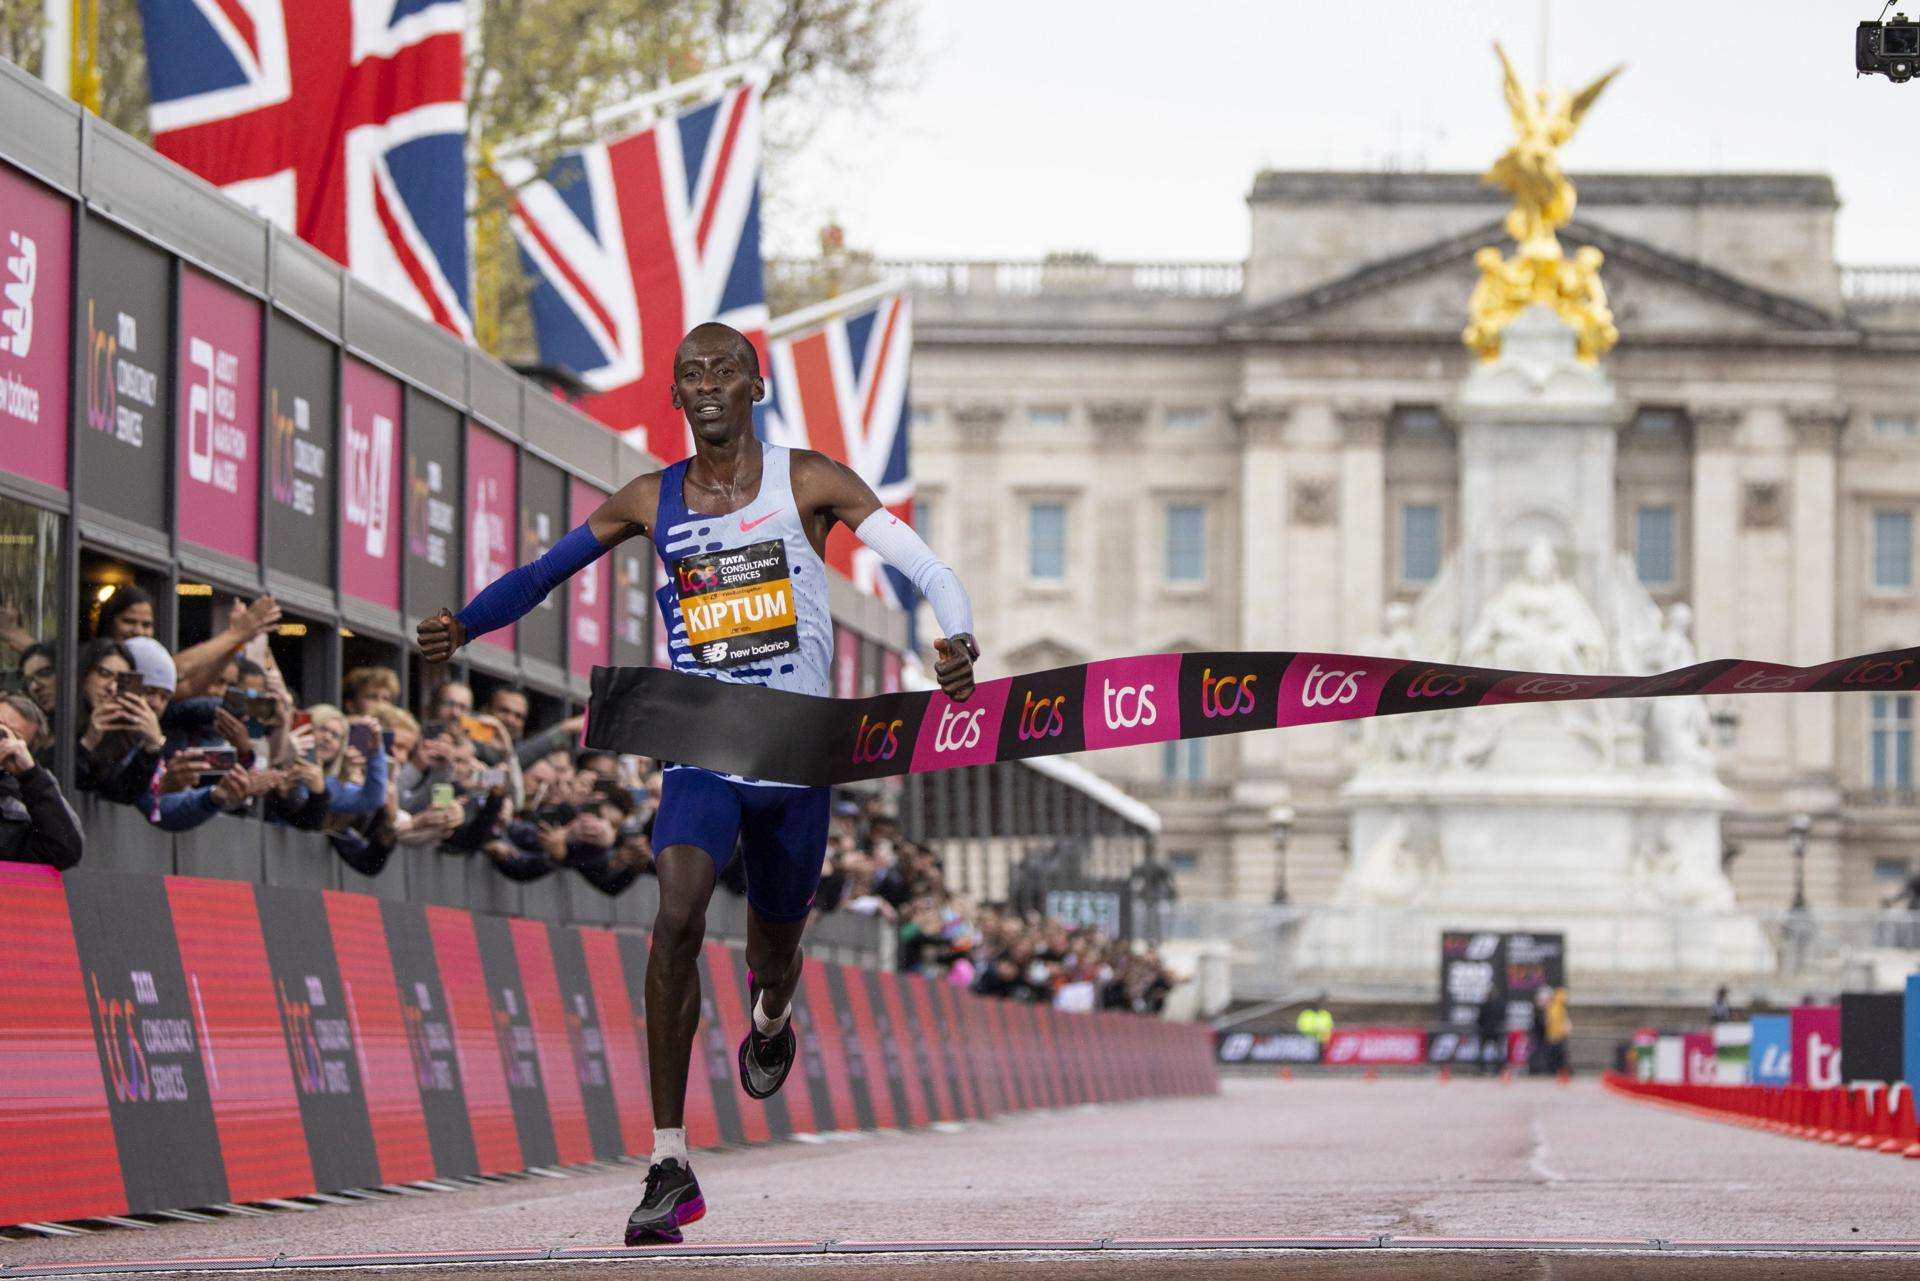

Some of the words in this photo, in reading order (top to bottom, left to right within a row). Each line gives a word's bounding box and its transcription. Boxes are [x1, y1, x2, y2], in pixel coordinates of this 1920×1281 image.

[719, 554, 746, 566] TATA
[721, 557, 780, 575] CONSULTANCY
[722, 570, 761, 584] SERVICES
[688, 590, 786, 632] KIPTUM
[730, 648, 751, 659] new
[752, 640, 790, 655] balance
[1302, 664, 1367, 707] tcs
[1406, 668, 1478, 698] tcs
[1733, 671, 1809, 690] tcs
[1843, 659, 1915, 685] tcs
[1103, 678, 1157, 730] tcs
[1202, 667, 1258, 719] tcs
[935, 703, 986, 753] tcs
[1018, 691, 1066, 741] tcs
[852, 714, 904, 765] tcs
